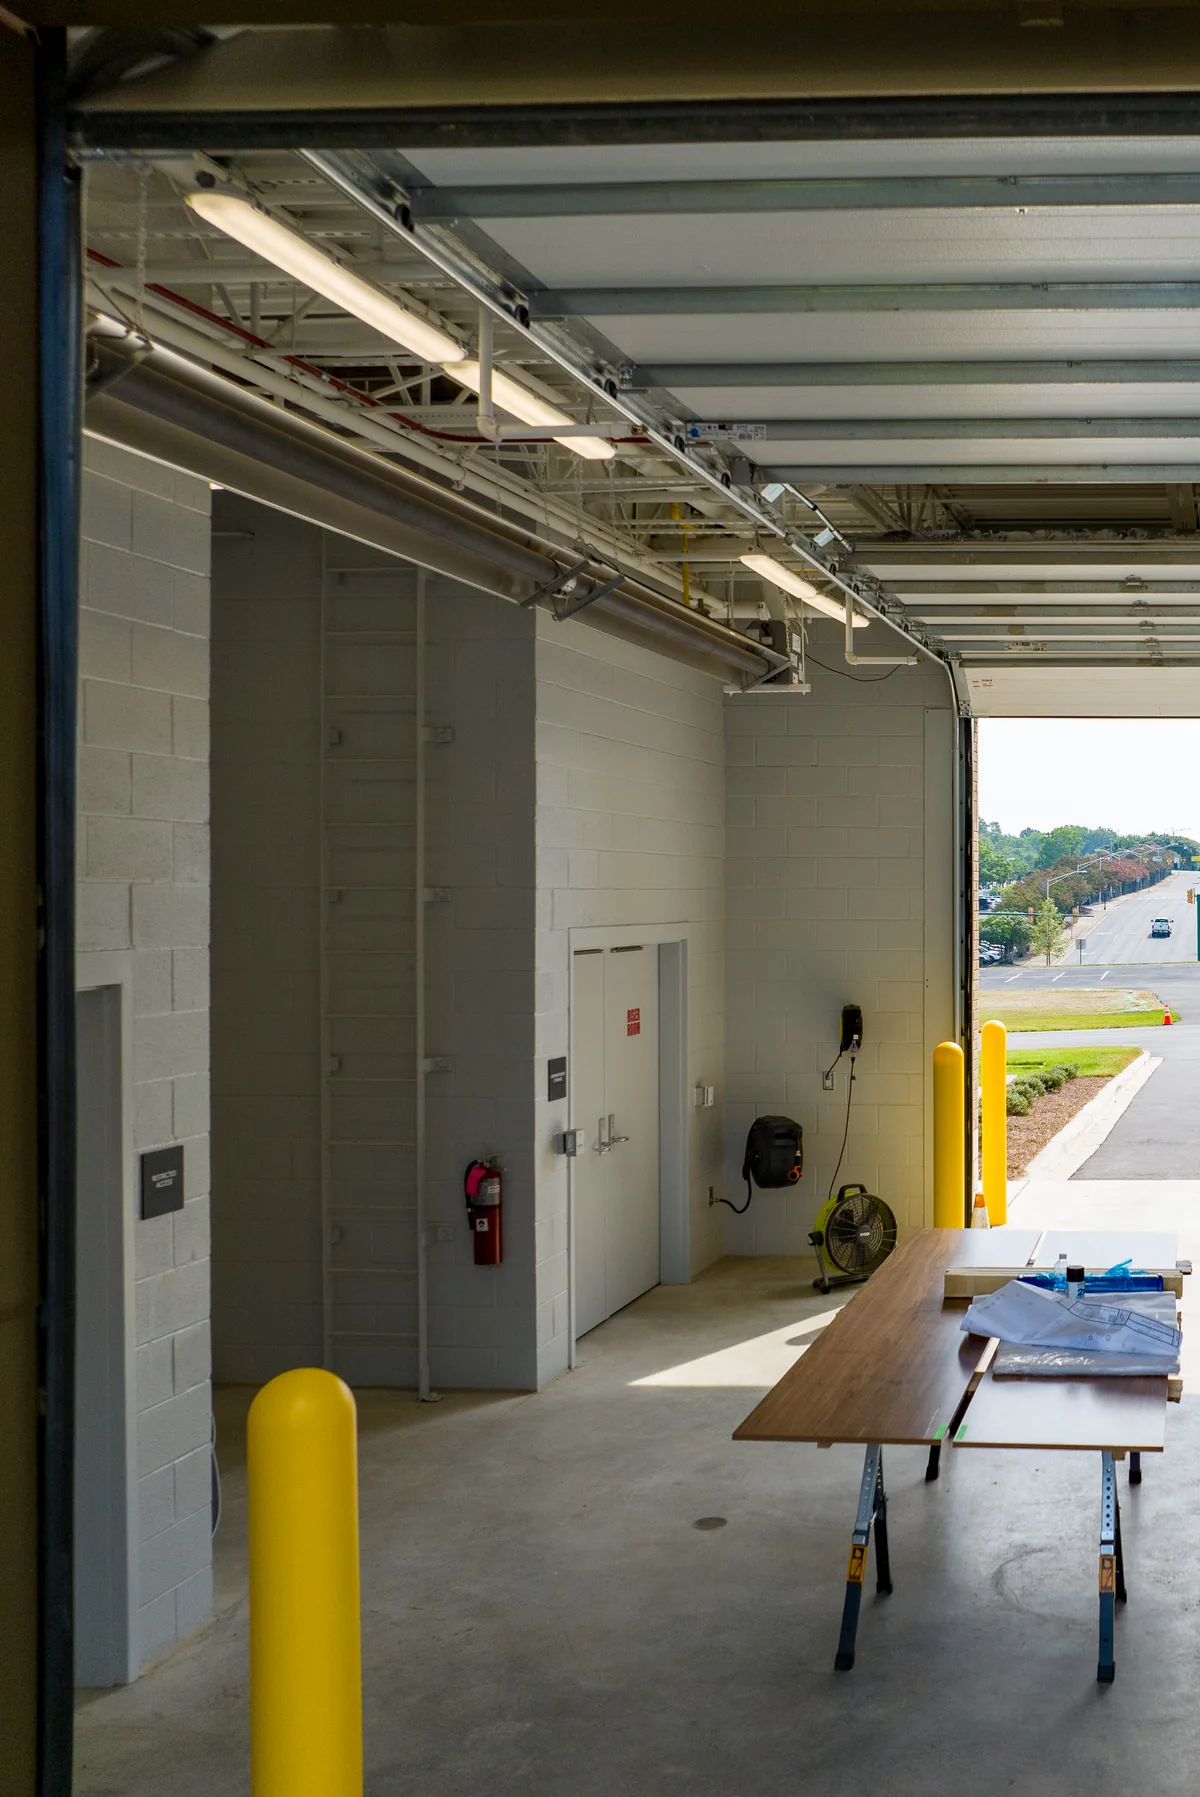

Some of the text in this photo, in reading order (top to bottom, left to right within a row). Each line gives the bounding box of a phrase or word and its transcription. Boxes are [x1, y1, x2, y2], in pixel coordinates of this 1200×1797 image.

[627, 1008, 640, 1023] RISER
[627, 1021, 640, 1037] ROOM
[156, 1178, 173, 1188] ACCESS
